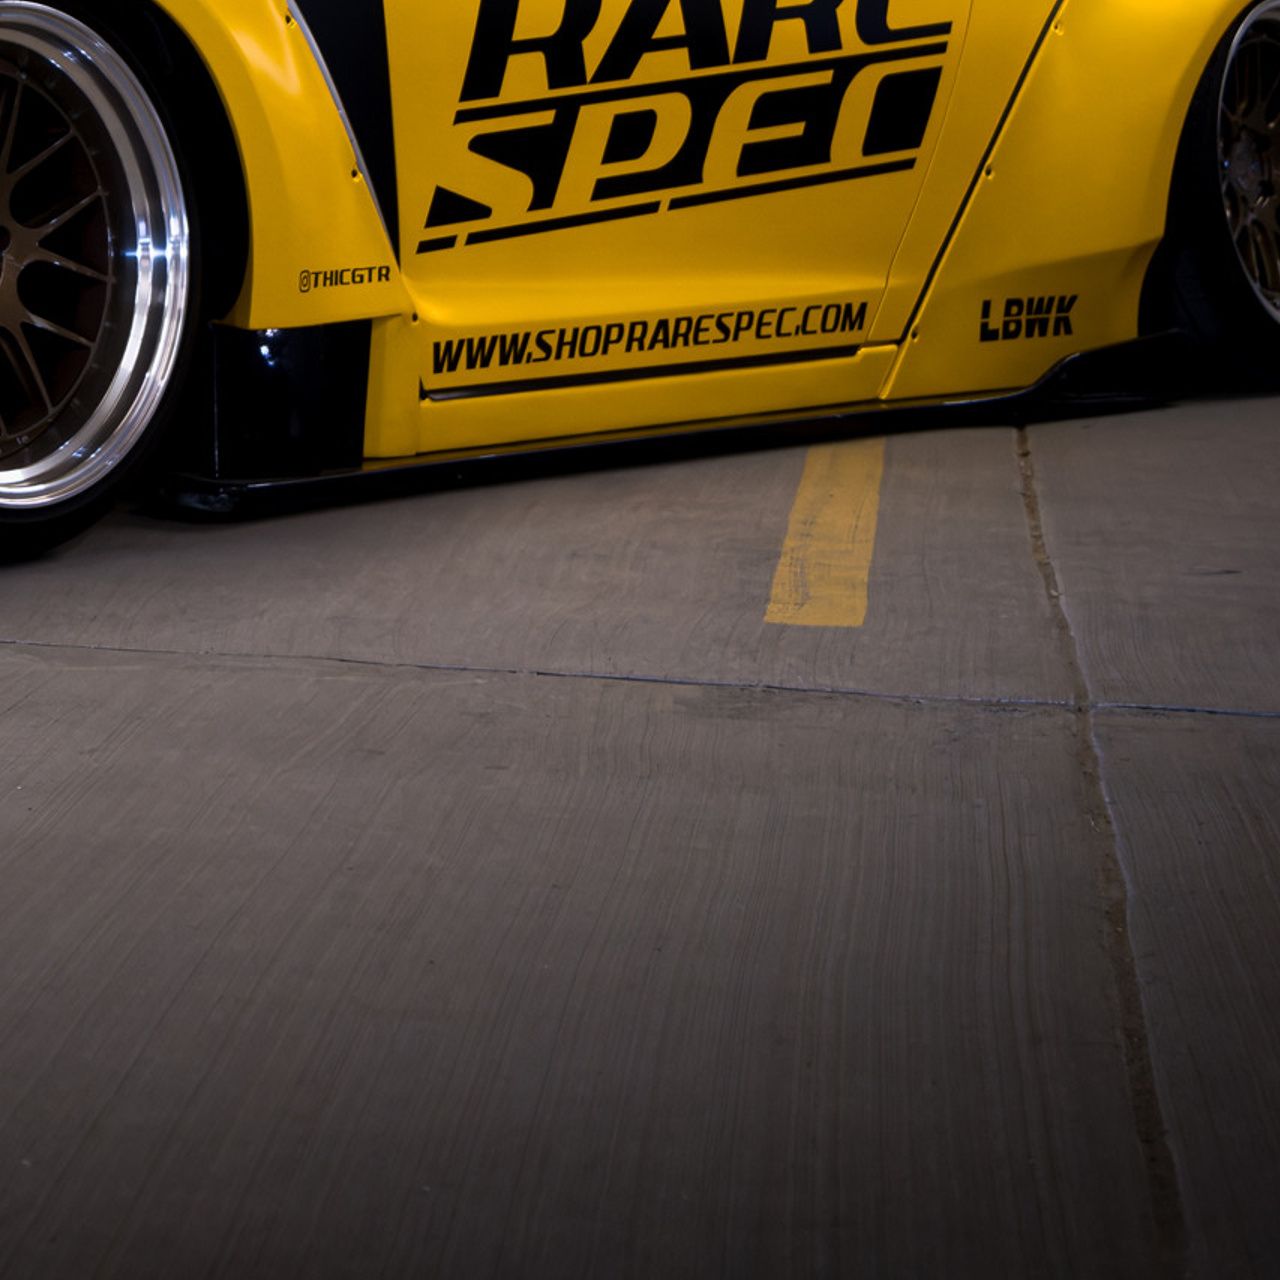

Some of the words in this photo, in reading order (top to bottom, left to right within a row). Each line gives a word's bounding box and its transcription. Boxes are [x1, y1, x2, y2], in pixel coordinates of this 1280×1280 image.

[420, 57, 944, 238] SPEC
[299, 265, 390, 293] @THICGTR
[432, 301, 868, 374] WWW.SHOPRARESPEC.COM
[979, 293, 1079, 342] LBWK
